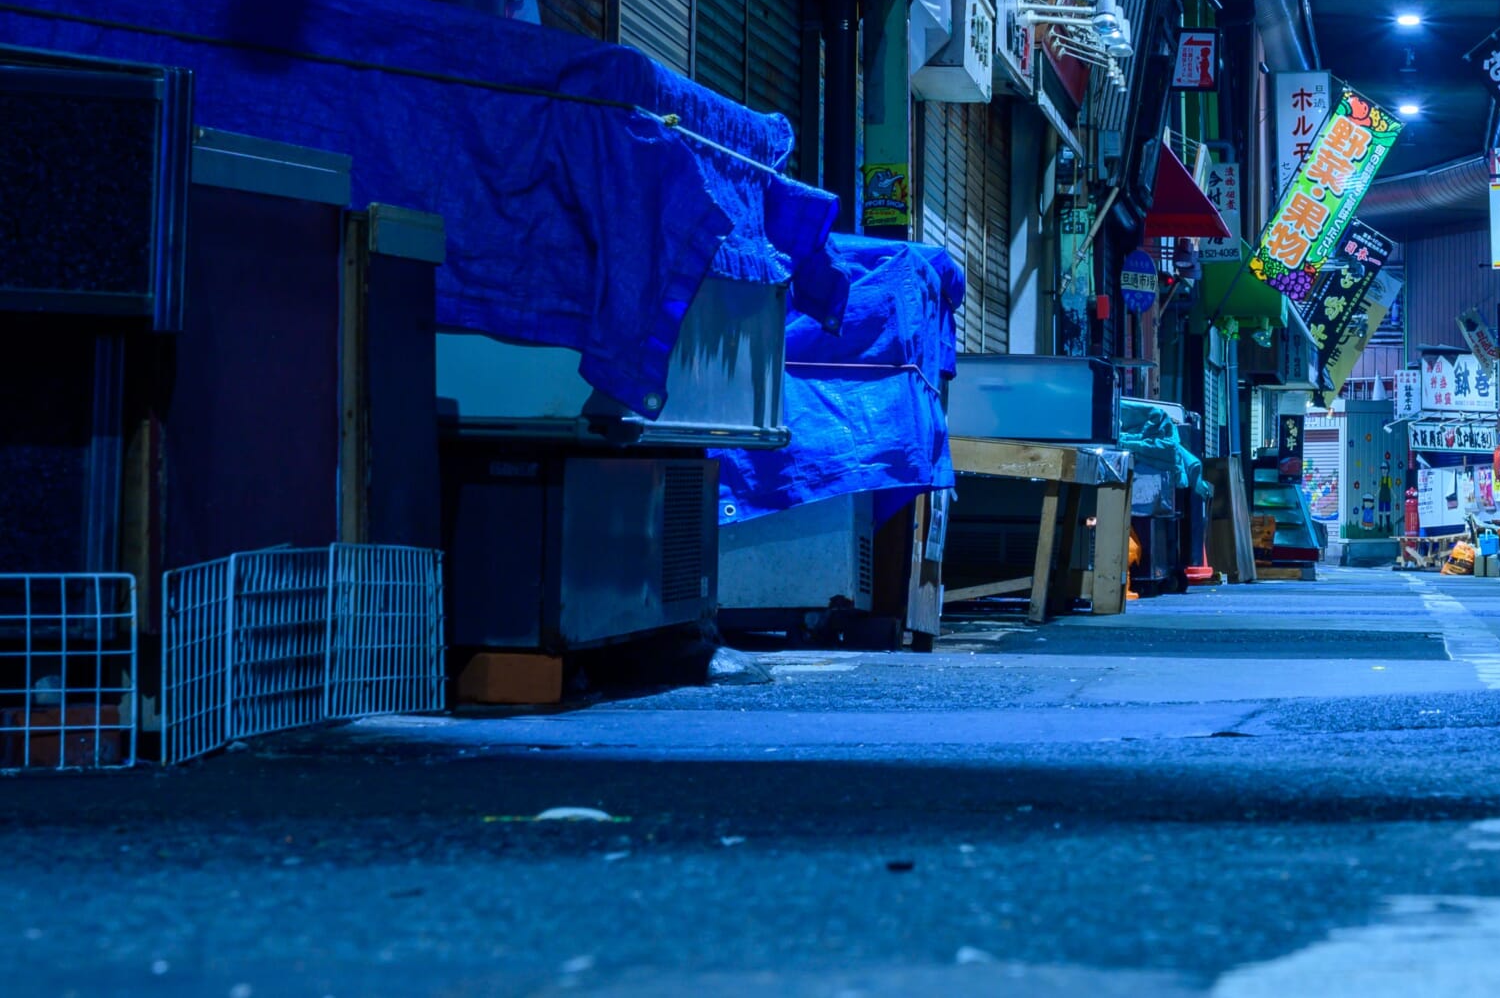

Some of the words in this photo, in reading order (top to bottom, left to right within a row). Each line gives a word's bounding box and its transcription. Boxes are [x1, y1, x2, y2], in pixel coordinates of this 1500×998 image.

[1292, 87, 1314, 173] ホルモ
[1268, 116, 1371, 268] 野菜・果物
